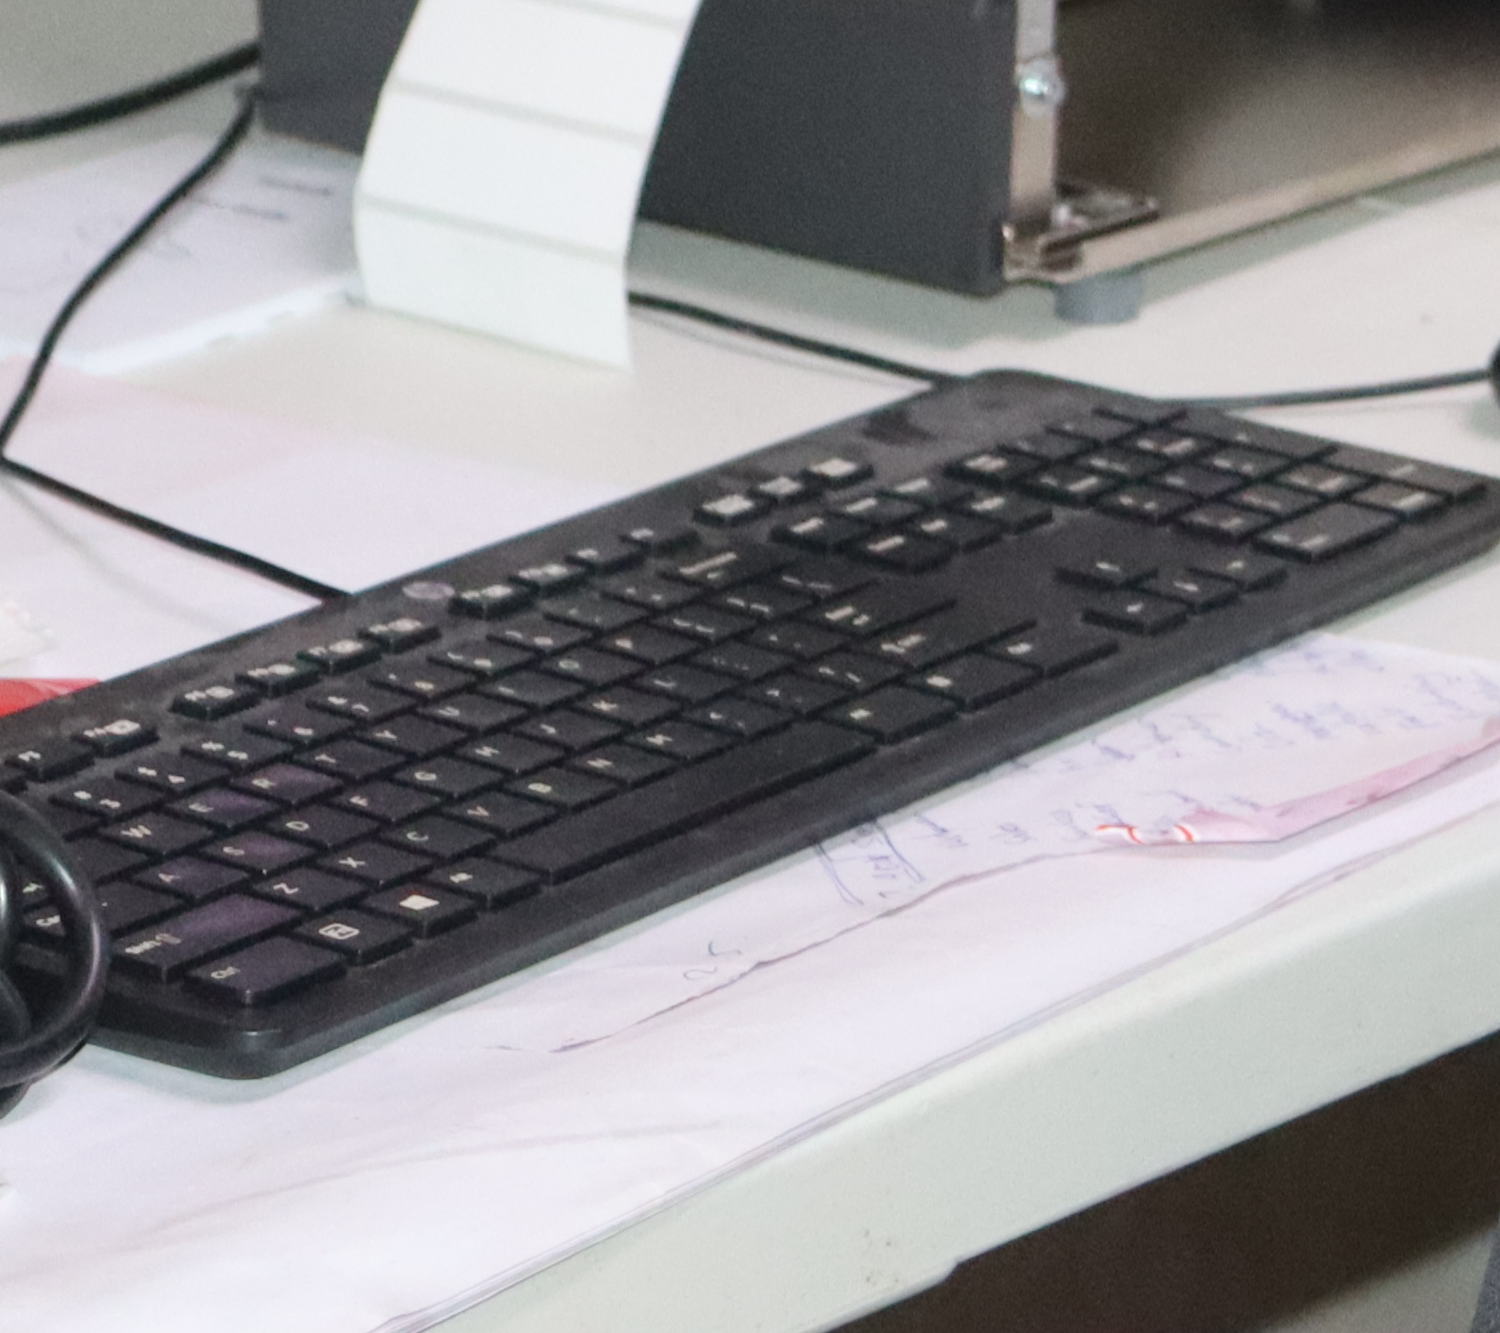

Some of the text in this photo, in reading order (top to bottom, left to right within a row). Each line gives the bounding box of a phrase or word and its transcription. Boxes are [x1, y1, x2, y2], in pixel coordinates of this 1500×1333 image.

[251, 777, 277, 789] R
[188, 801, 214, 813] E
[121, 824, 152, 839] W
[339, 856, 365, 869] X
[158, 872, 181, 884] A
